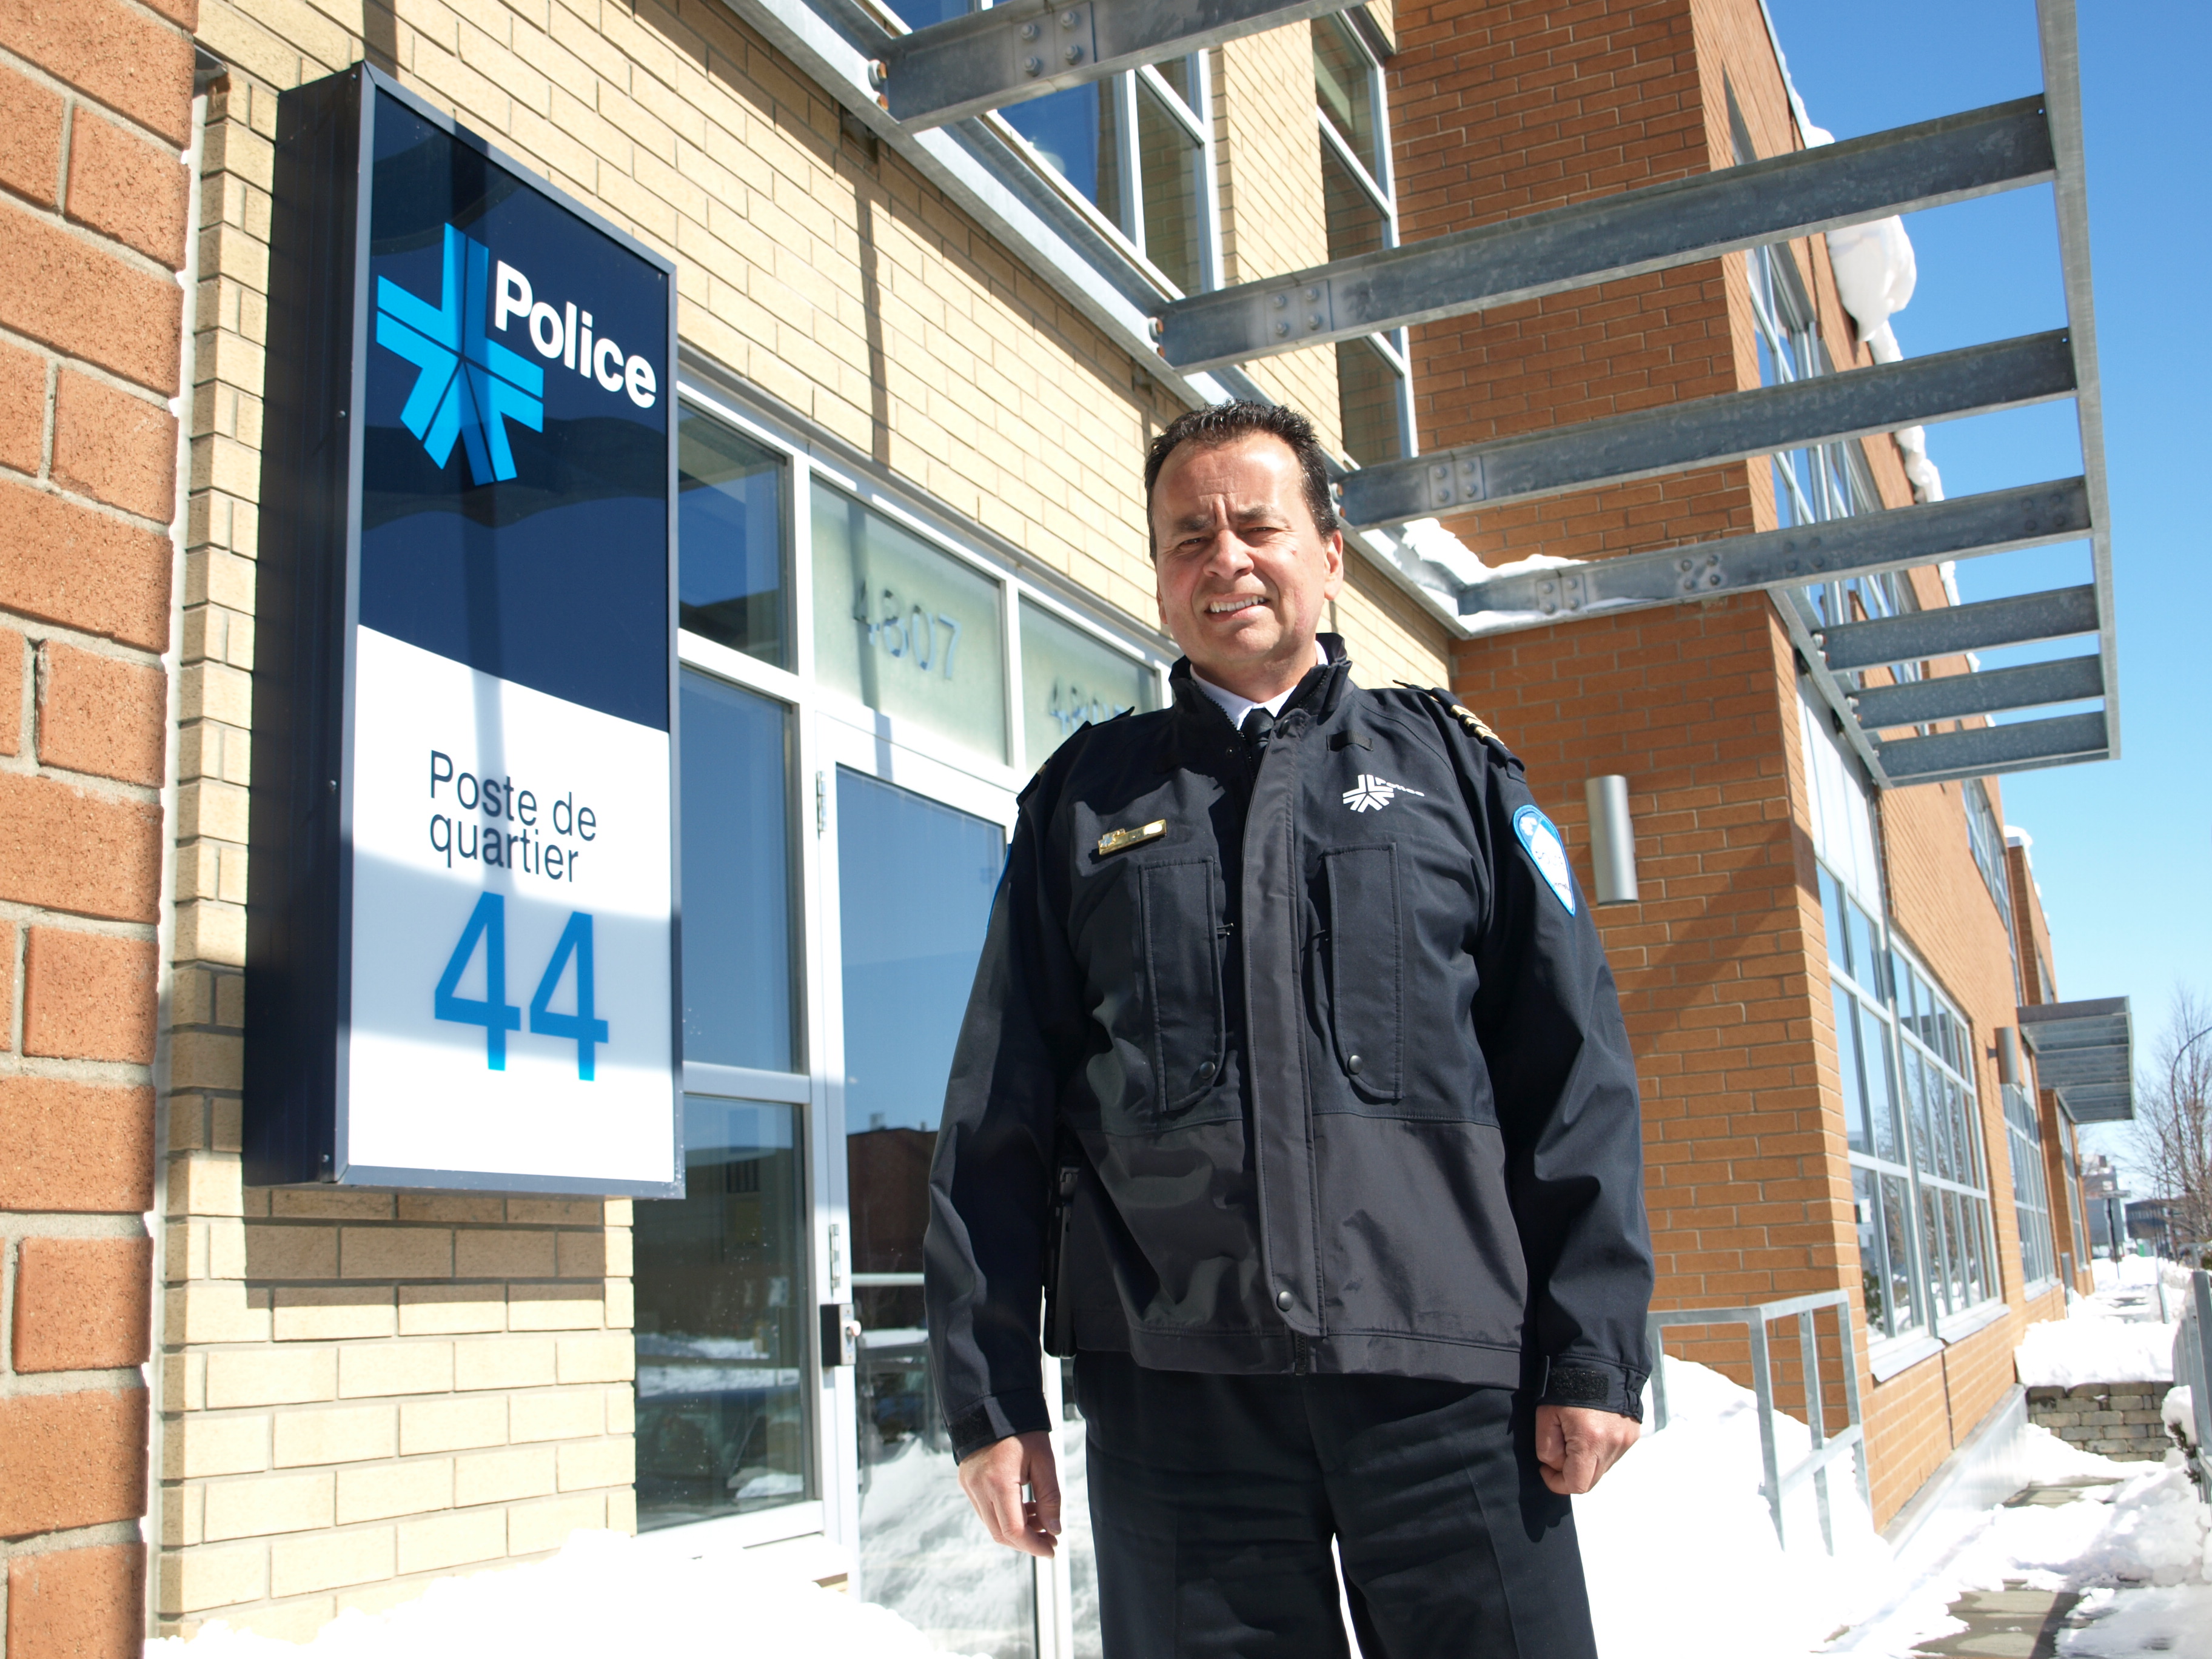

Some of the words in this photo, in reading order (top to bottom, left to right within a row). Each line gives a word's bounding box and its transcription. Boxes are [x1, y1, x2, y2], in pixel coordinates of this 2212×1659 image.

[495, 260, 656, 408] Police
[430, 749, 537, 826] Poste
[552, 791, 597, 842] de
[430, 813, 579, 883] quartier
[434, 891, 609, 1082] 44
